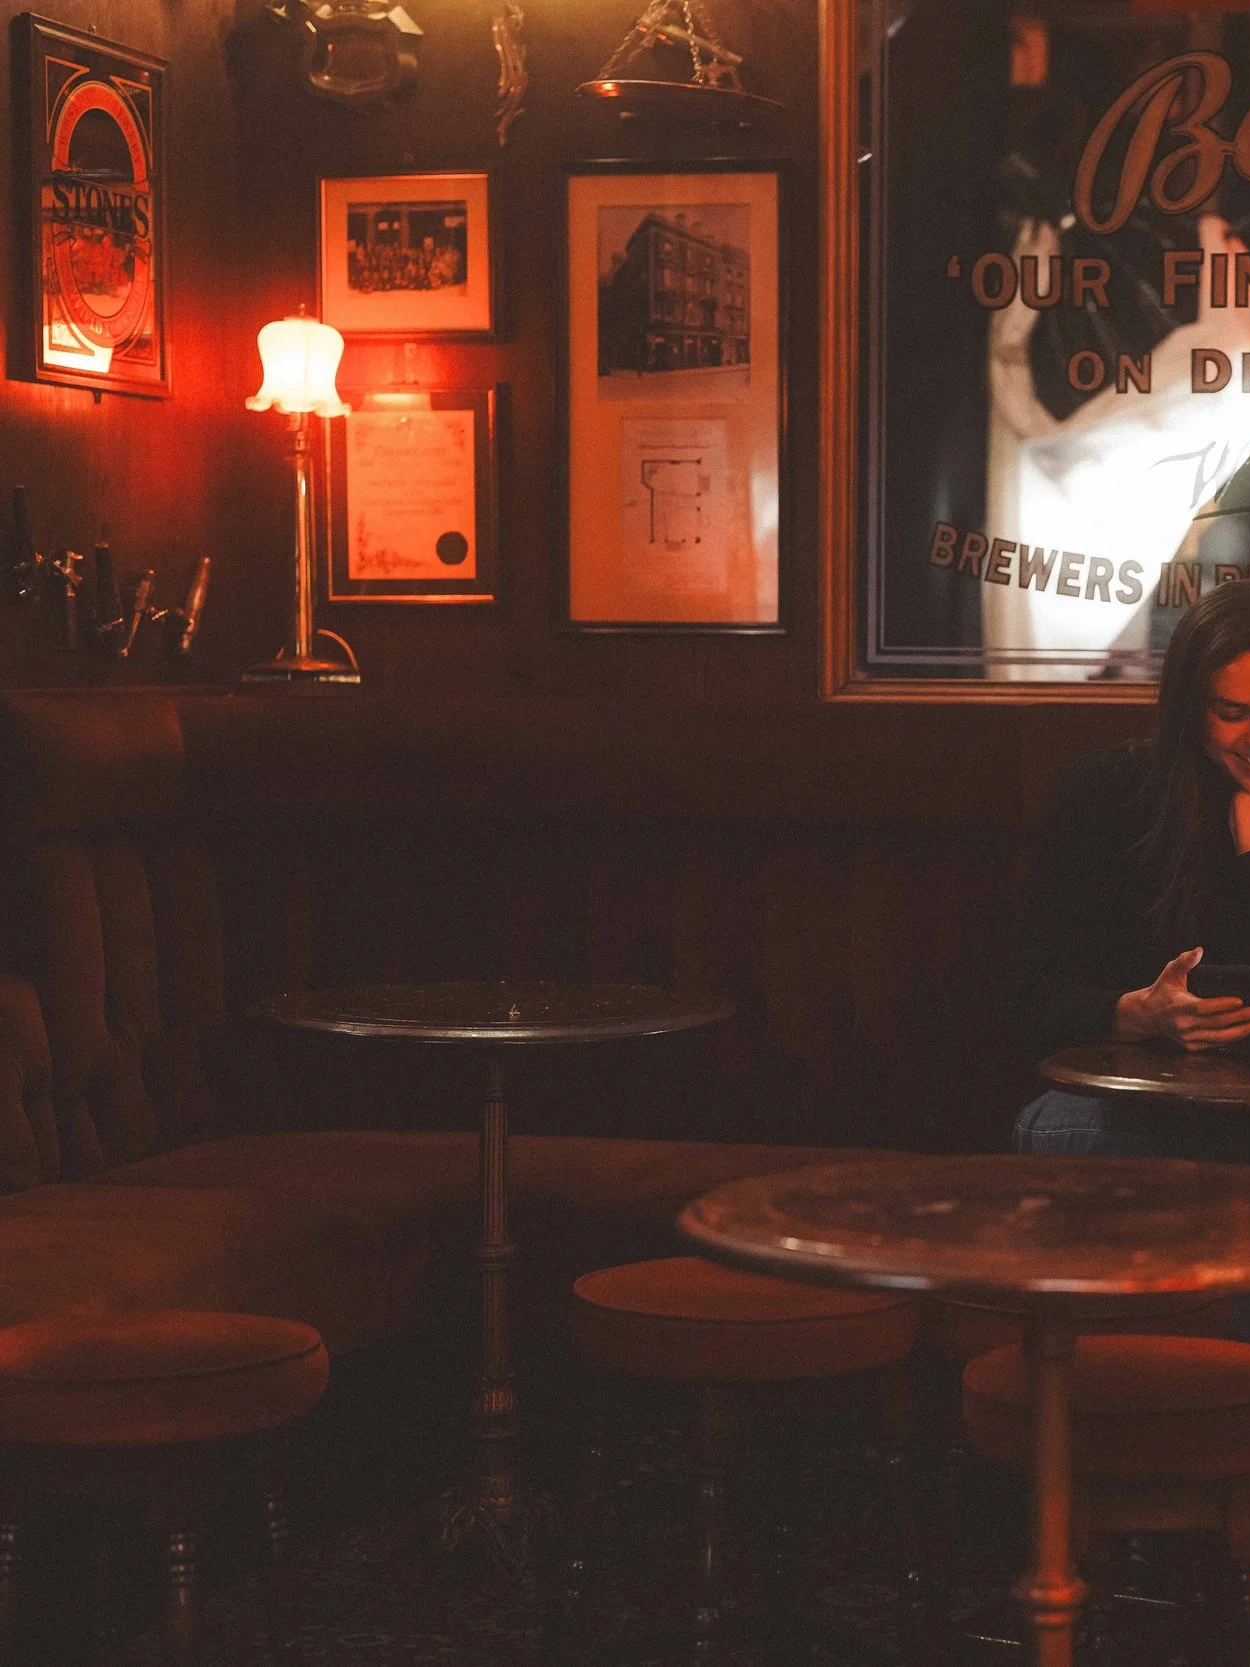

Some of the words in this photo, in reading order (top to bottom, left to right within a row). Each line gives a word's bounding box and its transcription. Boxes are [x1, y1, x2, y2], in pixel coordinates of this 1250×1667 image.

[51, 178, 149, 238] STONES
[1067, 349, 1153, 394] ON
[928, 520, 1145, 605] BREWERS
[1157, 561, 1201, 607] IN
